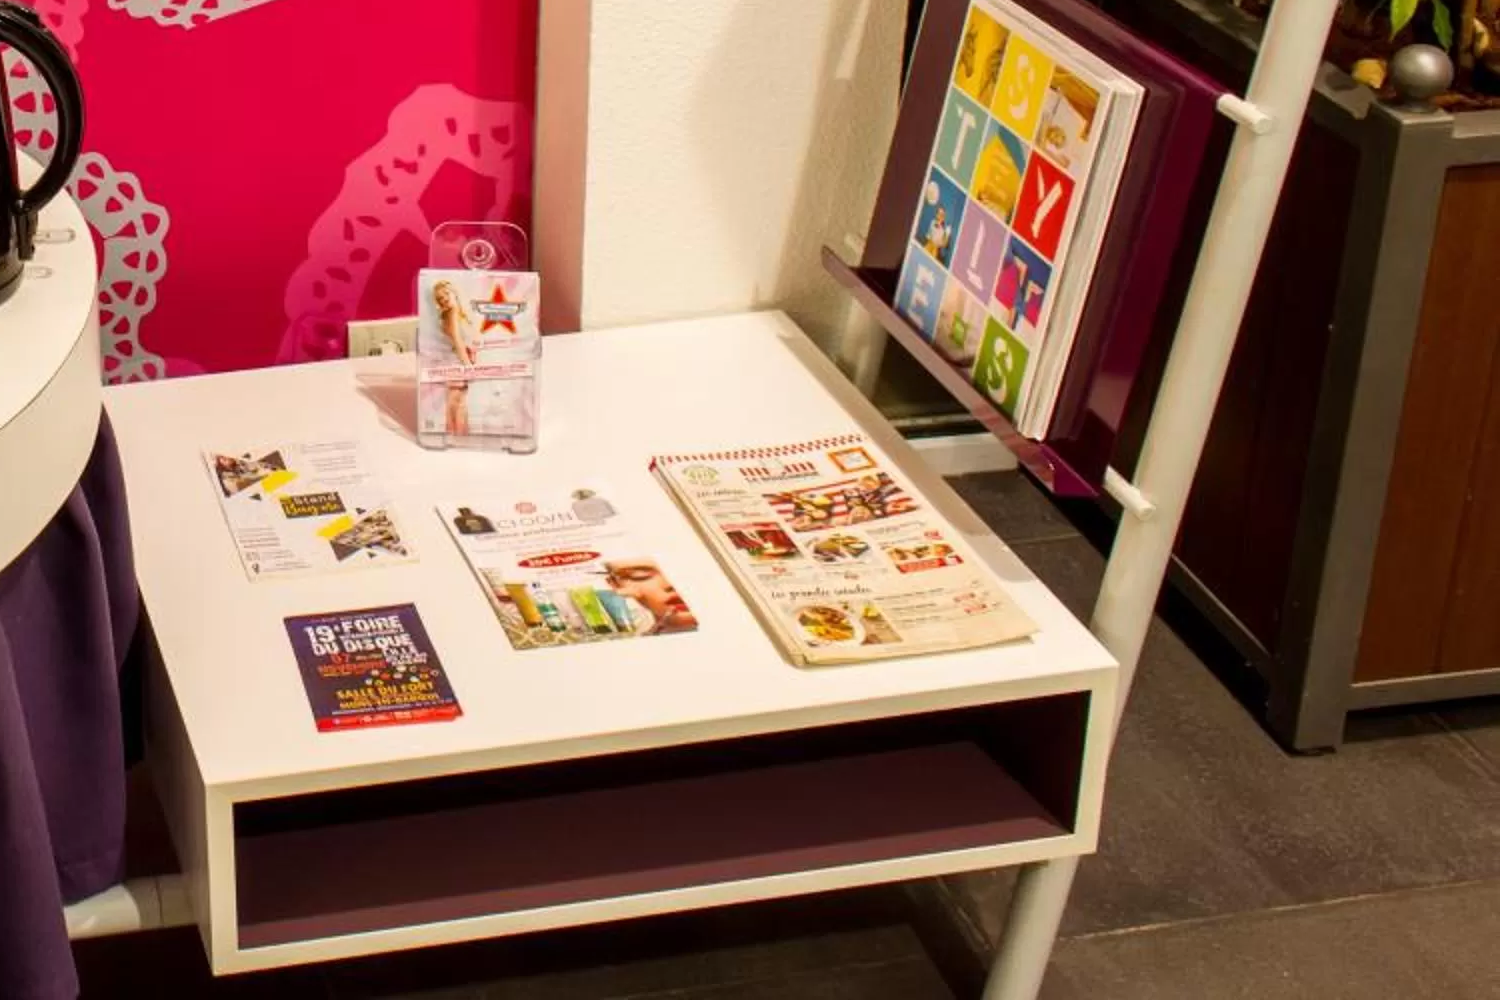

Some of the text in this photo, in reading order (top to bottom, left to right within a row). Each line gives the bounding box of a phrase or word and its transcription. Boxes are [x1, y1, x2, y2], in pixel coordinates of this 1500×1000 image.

[340, 615, 402, 633] FOIRE
[312, 639, 340, 656] DU
[344, 633, 413, 653] DISQUE
